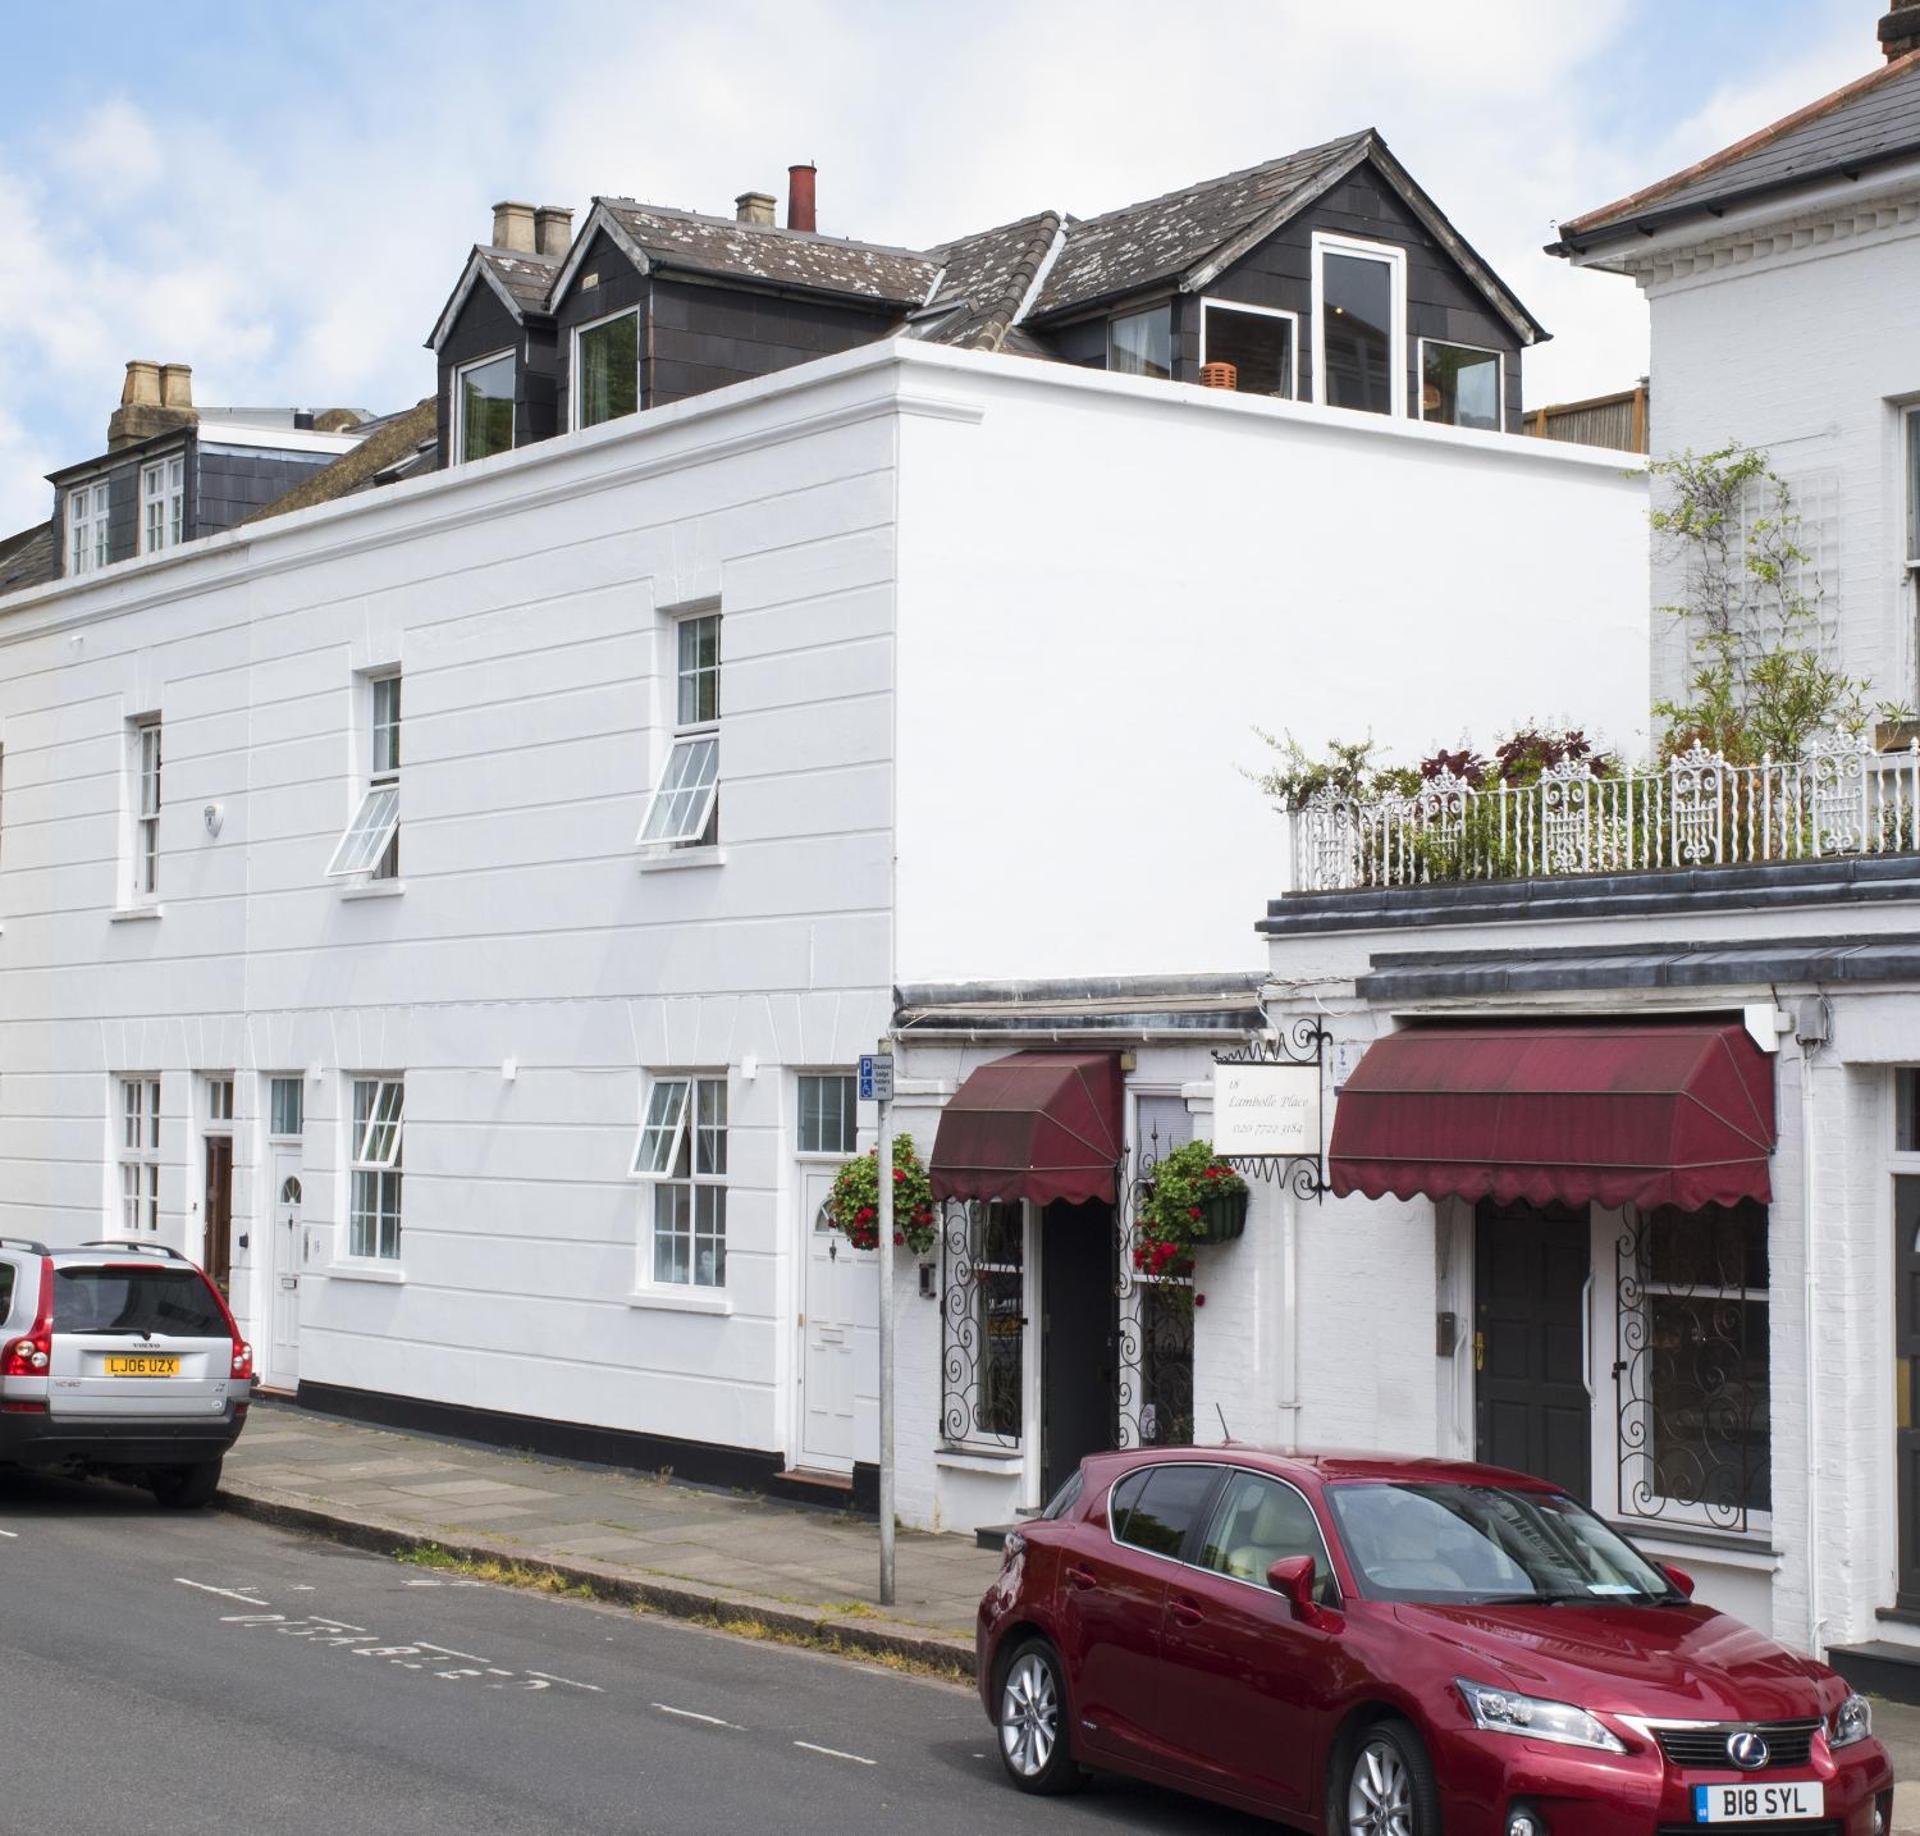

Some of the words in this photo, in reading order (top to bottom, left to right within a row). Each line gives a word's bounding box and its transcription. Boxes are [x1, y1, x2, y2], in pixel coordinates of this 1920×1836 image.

[863, 1060, 871, 1076] P
[1280, 1094, 1309, 1108] Place
[110, 1359, 145, 1373] LJ06
[149, 1359, 175, 1373] UZX
[1764, 1788, 1807, 1814] SYL
